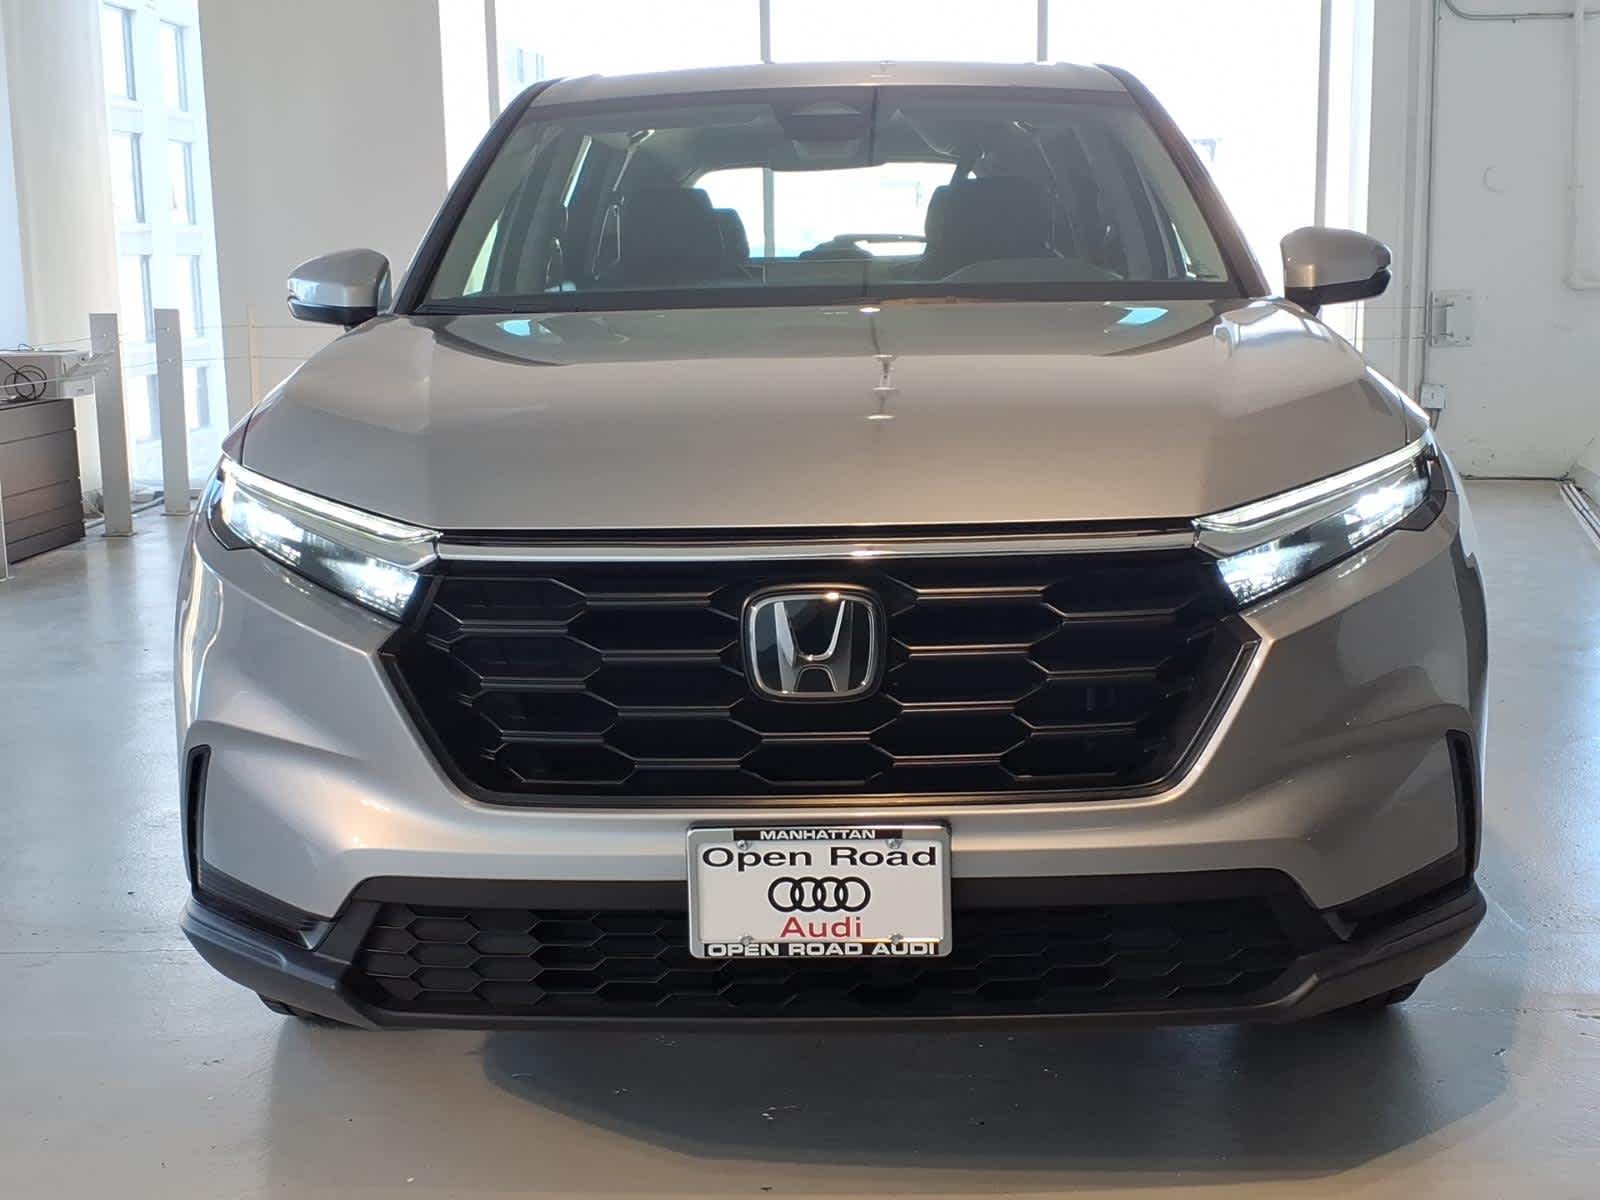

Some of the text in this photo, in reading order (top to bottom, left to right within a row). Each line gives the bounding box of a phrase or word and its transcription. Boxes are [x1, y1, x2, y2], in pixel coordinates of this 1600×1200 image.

[760, 829, 876, 840] MANHATTAN
[702, 847, 936, 872] Open Road
[780, 916, 862, 938] Audi
[708, 943, 935, 956] OPEN ROAD AUDI
